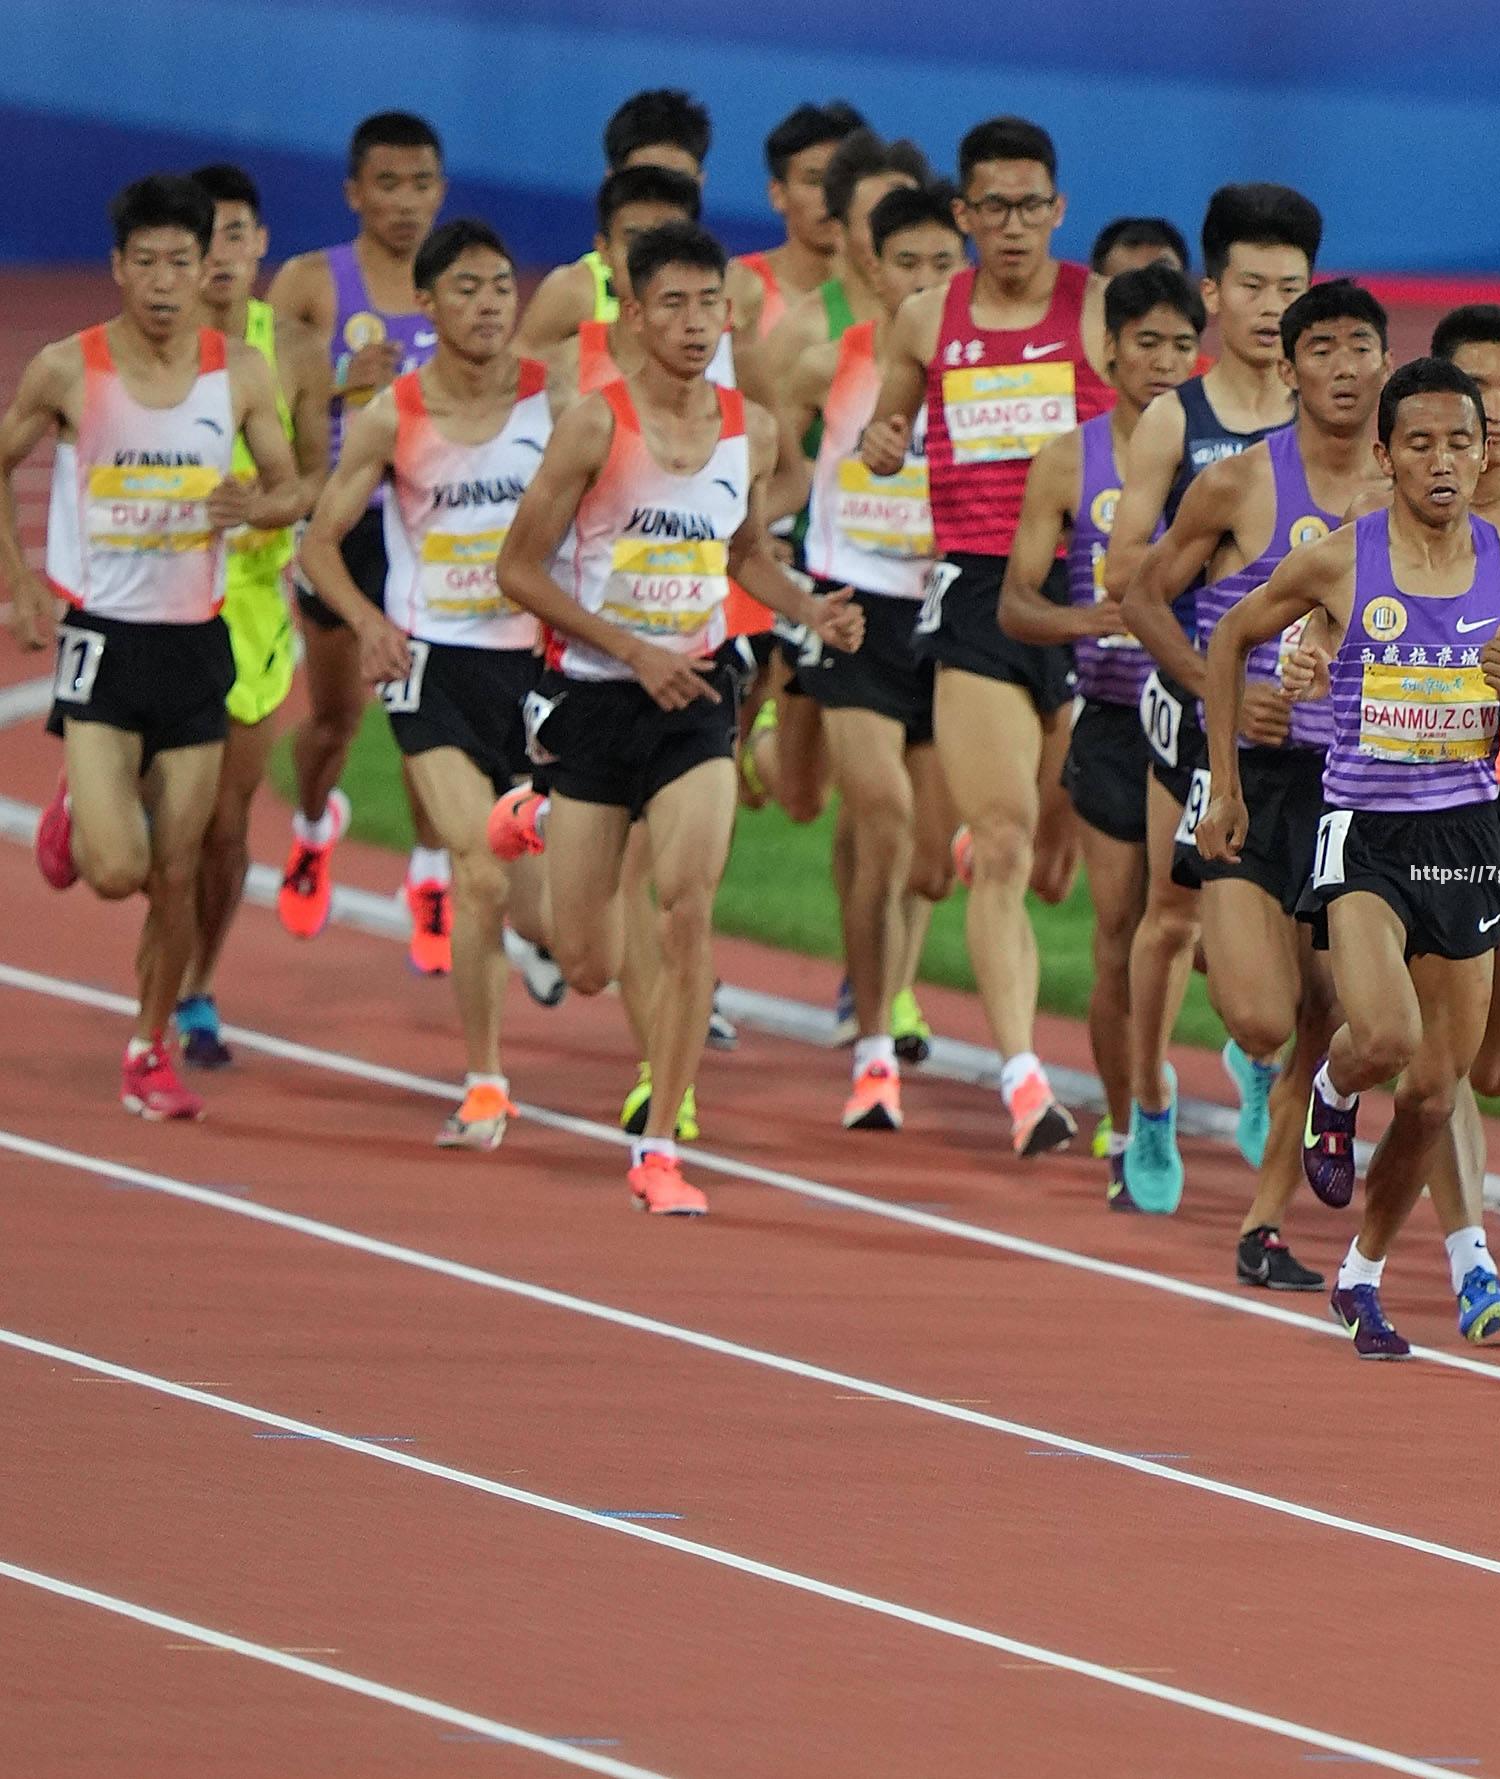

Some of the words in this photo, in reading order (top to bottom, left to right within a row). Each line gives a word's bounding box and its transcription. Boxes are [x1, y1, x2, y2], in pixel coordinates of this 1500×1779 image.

[624, 507, 715, 539] YUNNAN
[1149, 688, 1171, 749] 10
[1364, 704, 1497, 730] DANMU.Z.C.W
